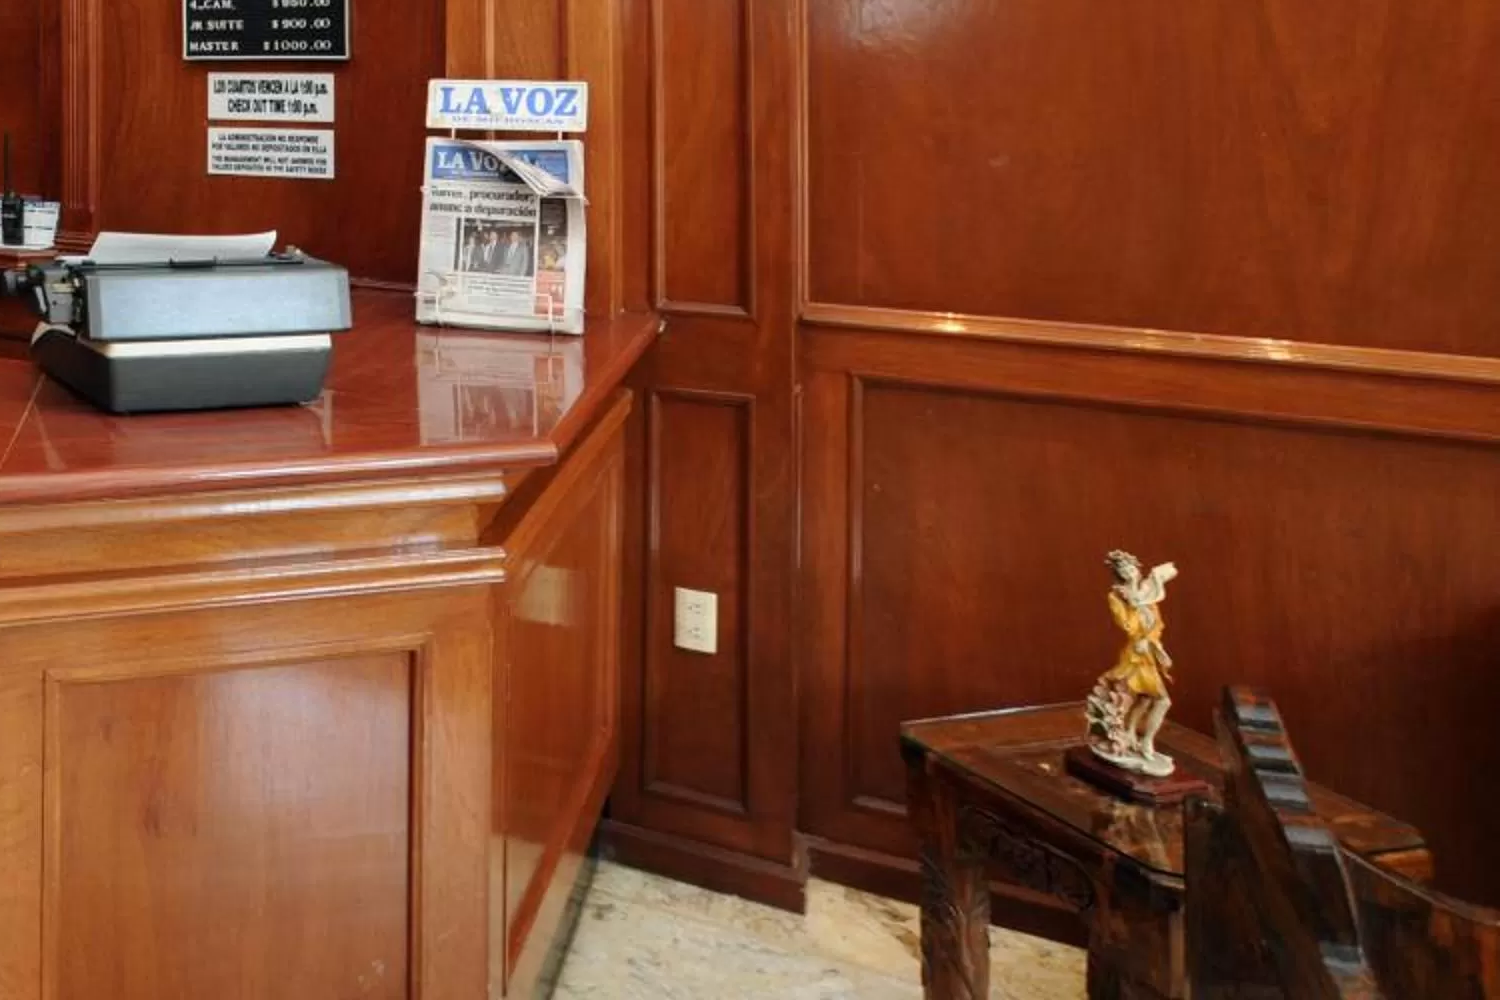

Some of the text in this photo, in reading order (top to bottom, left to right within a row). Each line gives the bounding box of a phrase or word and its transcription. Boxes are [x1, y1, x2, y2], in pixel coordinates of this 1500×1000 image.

[207, 20, 243, 30] SUITE
[190, 42, 238, 51] MASTER
[228, 100, 250, 113] CHECK
[253, 100, 266, 112] OUT
[269, 100, 285, 113] TIME
[440, 87, 577, 116] LA VOZ
[437, 152, 464, 169] LA
